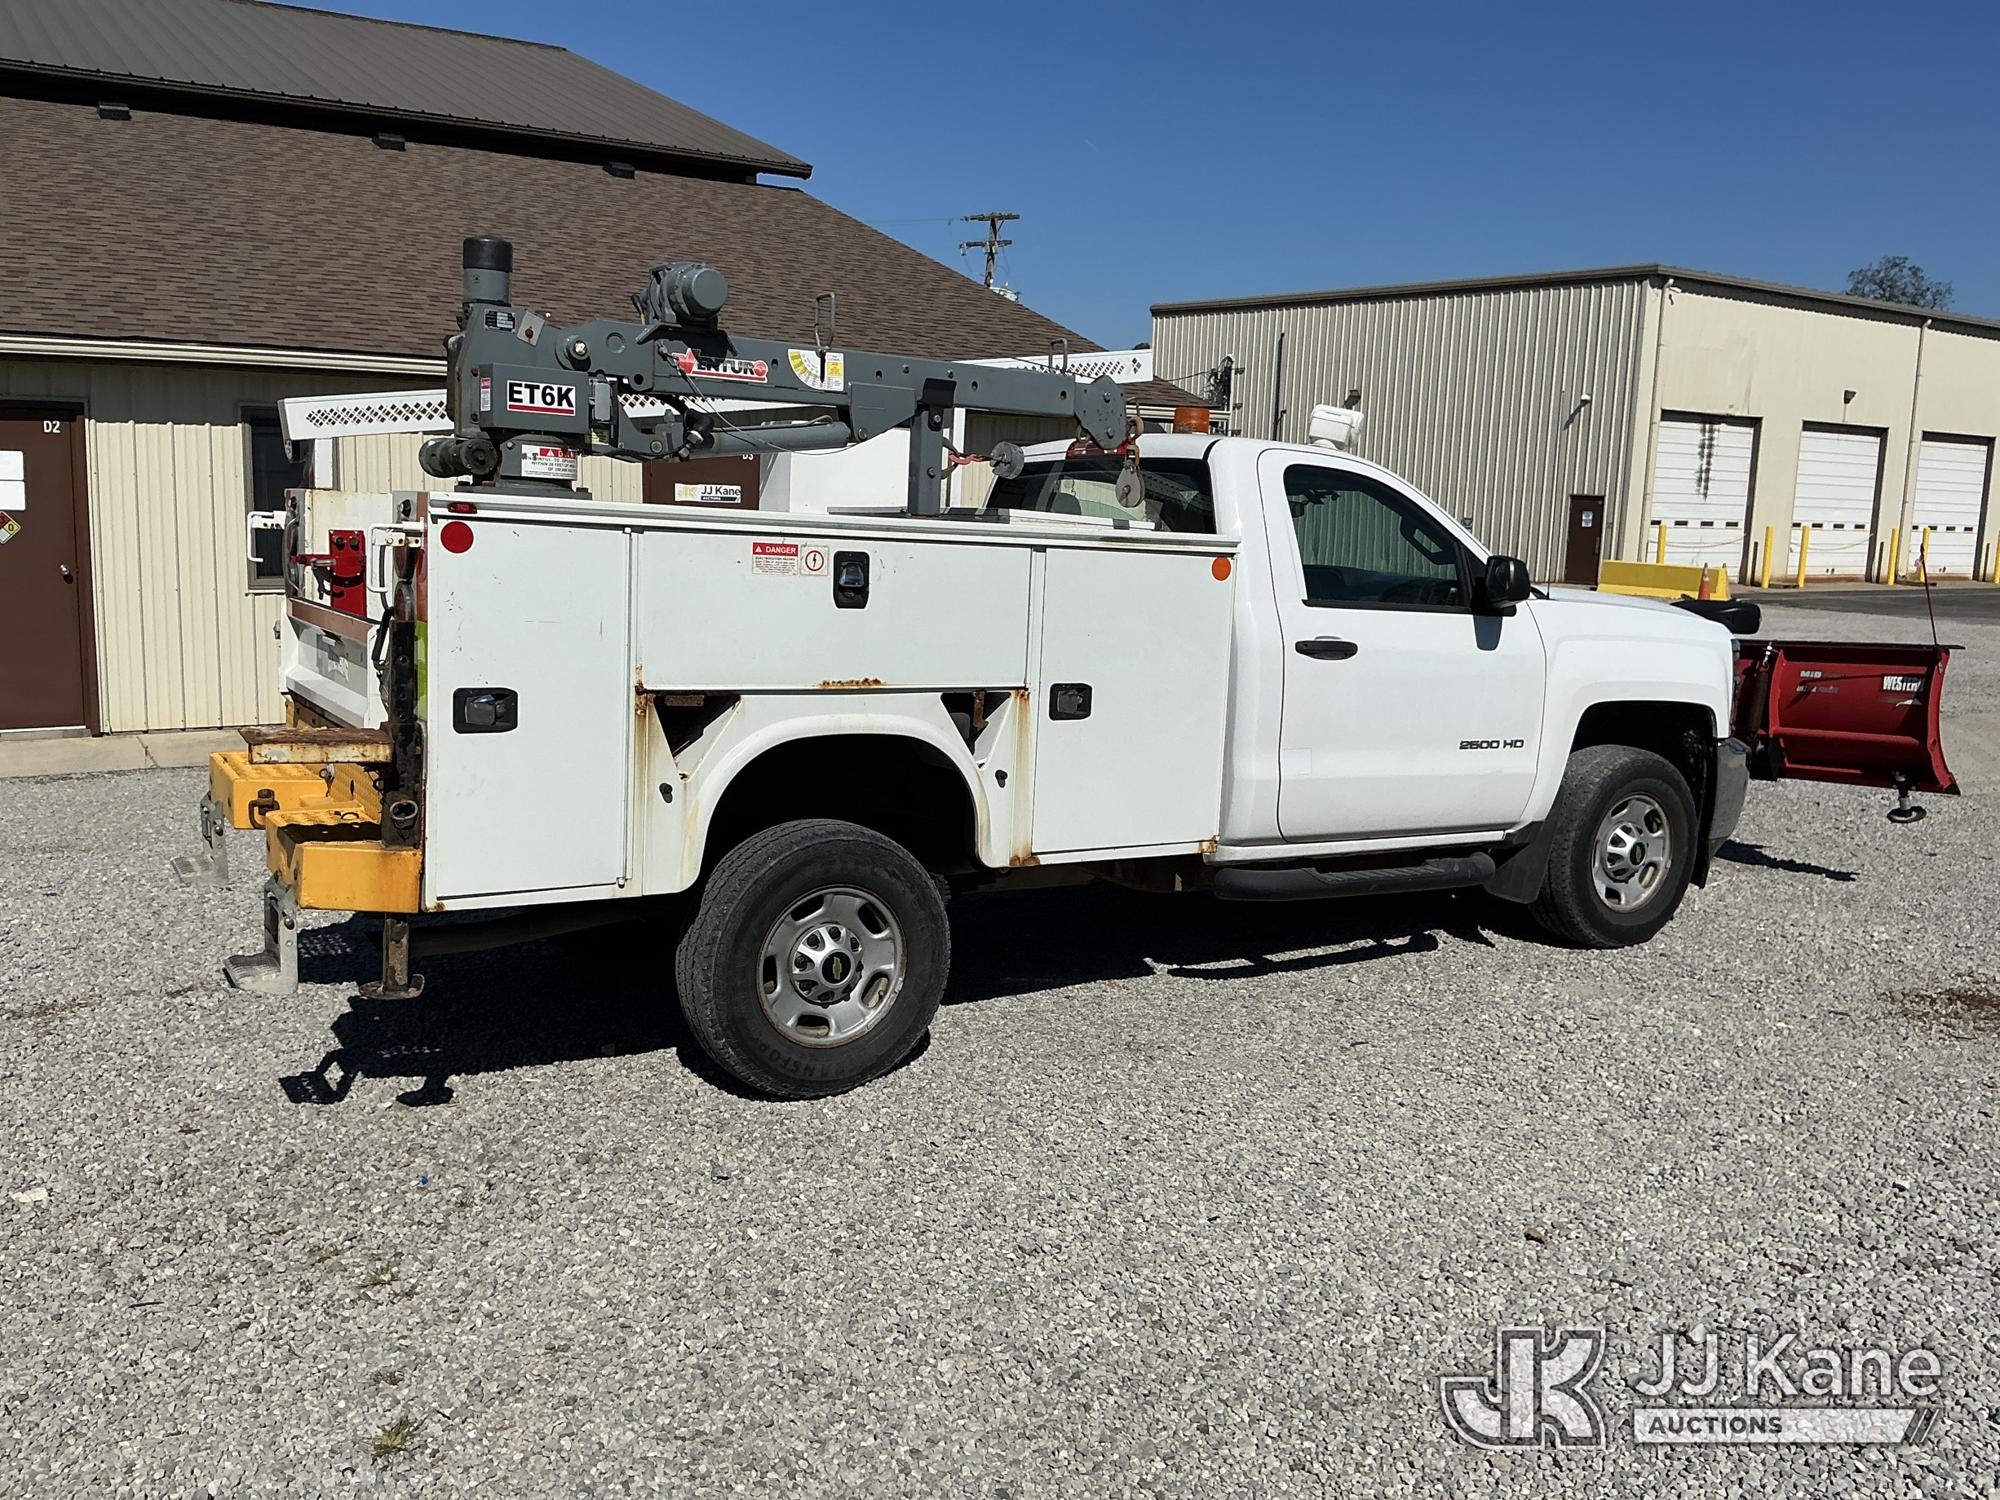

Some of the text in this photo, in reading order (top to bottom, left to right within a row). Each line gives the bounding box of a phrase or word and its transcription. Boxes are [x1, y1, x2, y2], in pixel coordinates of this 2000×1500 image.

[508, 382, 575, 408] ET6K
[43, 420, 61, 433] D2
[701, 485, 741, 496] JJ Kane
[765, 545, 797, 554] DANGER
[1502, 739, 1525, 749] HD
